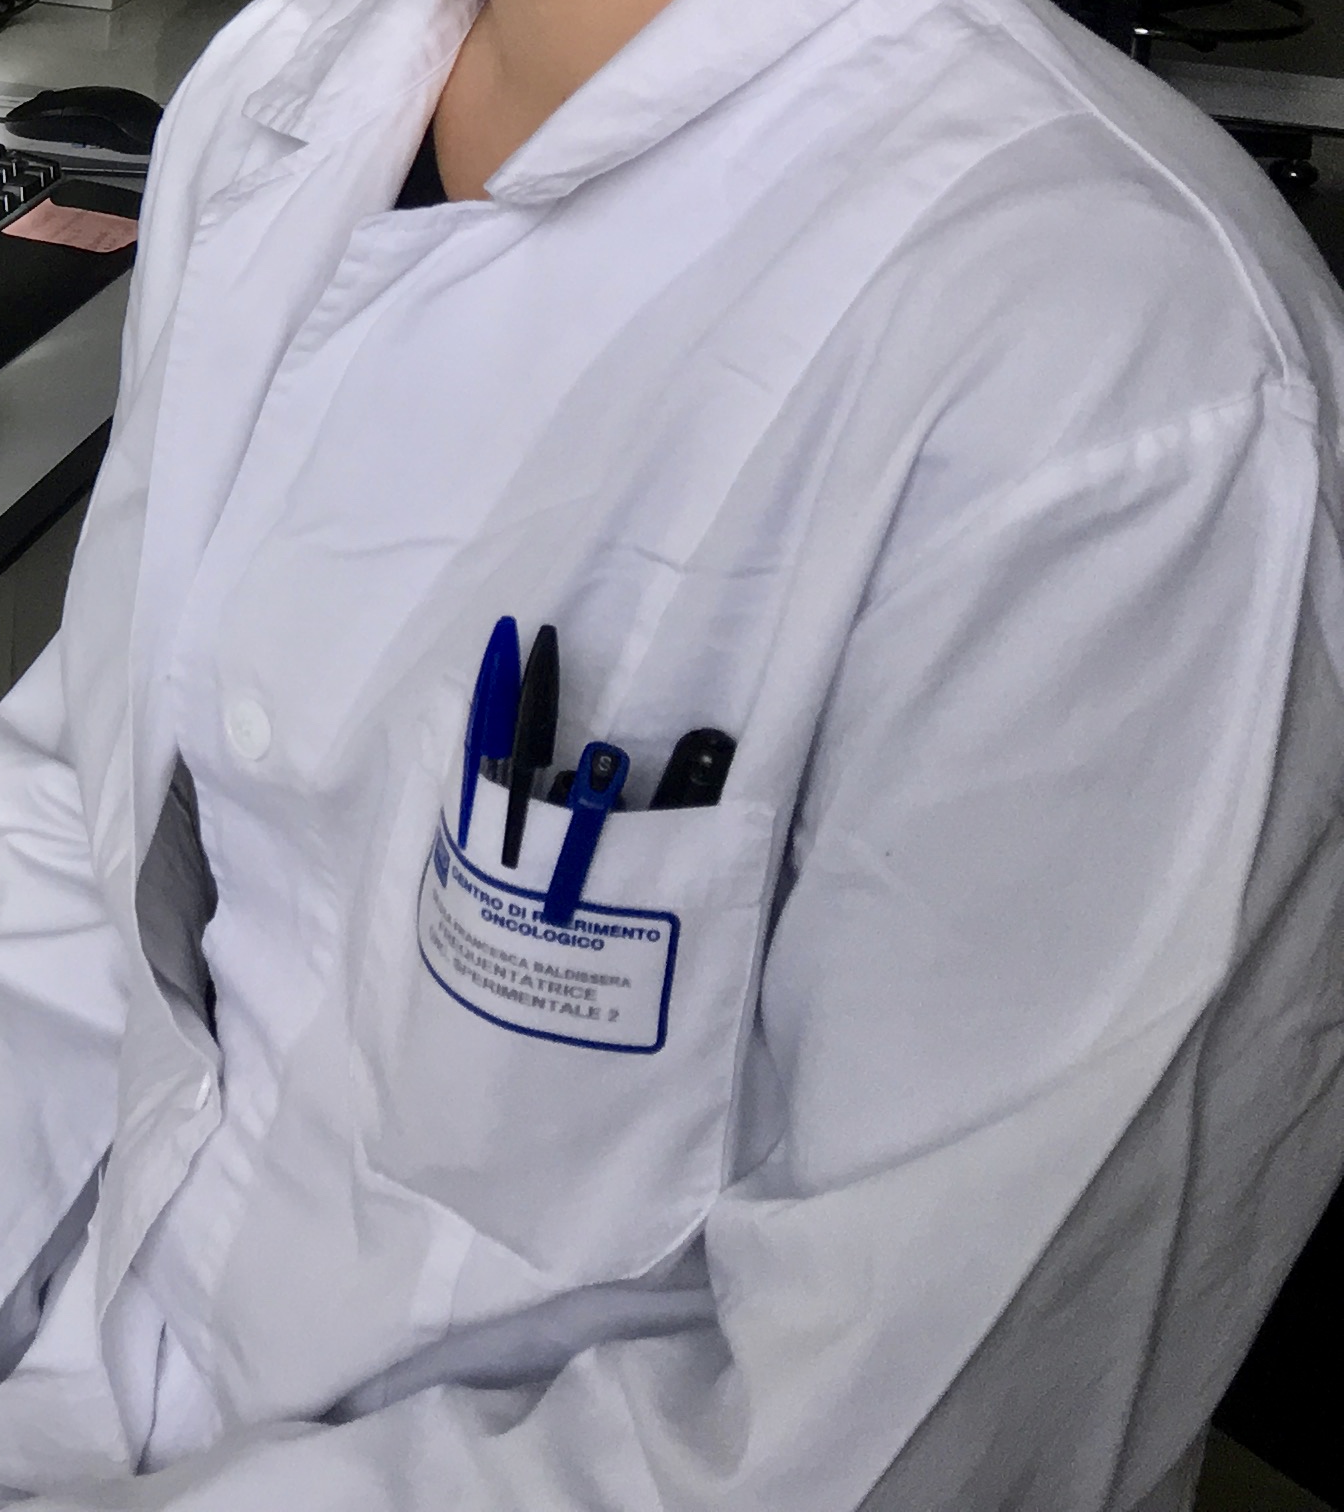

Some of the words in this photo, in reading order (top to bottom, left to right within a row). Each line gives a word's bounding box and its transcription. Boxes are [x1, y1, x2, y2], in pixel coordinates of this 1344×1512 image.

[452, 865, 504, 911] CENTRO
[508, 903, 527, 920] DI
[480, 907, 605, 951] ONCOLOGICO
[607, 1008, 620, 1023] 2
